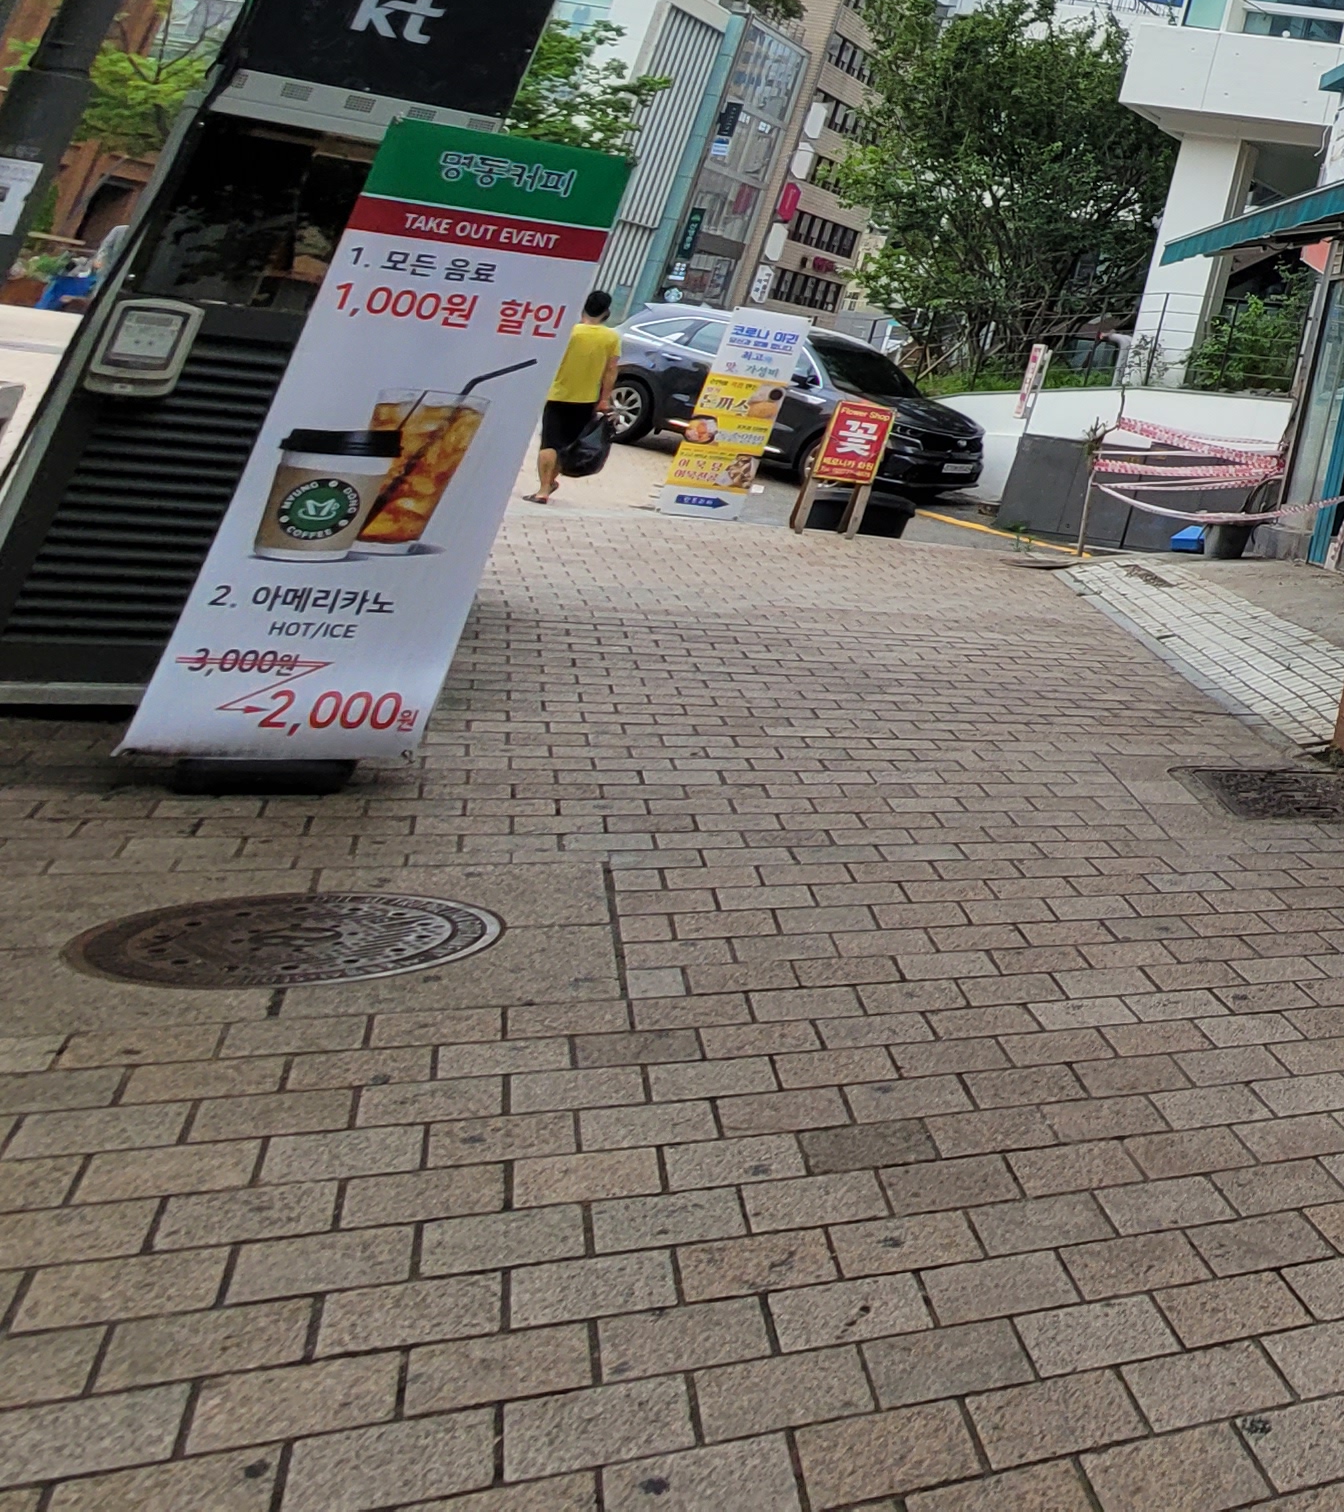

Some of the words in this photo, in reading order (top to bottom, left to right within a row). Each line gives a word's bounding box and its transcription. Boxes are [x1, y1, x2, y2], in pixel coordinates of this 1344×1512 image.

[440, 150, 577, 198] 명동커피
[404, 213, 453, 236] TAKE
[455, 220, 498, 241] OUT
[499, 228, 560, 250] EVENT
[380, 250, 438, 278] 모든
[444, 258, 498, 284] 음료
[335, 282, 479, 329] 1,000원
[496, 299, 567, 339] 할인
[840, 407, 869, 418] Flower
[869, 411, 891, 422] Shop
[836, 419, 879, 457] 꽃
[281, 480, 320, 510] MYUNG
[343, 486, 357, 515] DONG
[286, 525, 333, 540] COFFEE
[208, 584, 238, 608] 2.
[251, 586, 395, 616] 아메리카노
[268, 621, 358, 639] HOT/ICE
[186, 647, 301, 677] 3,000원
[257, 689, 420, 737] 2,000원
